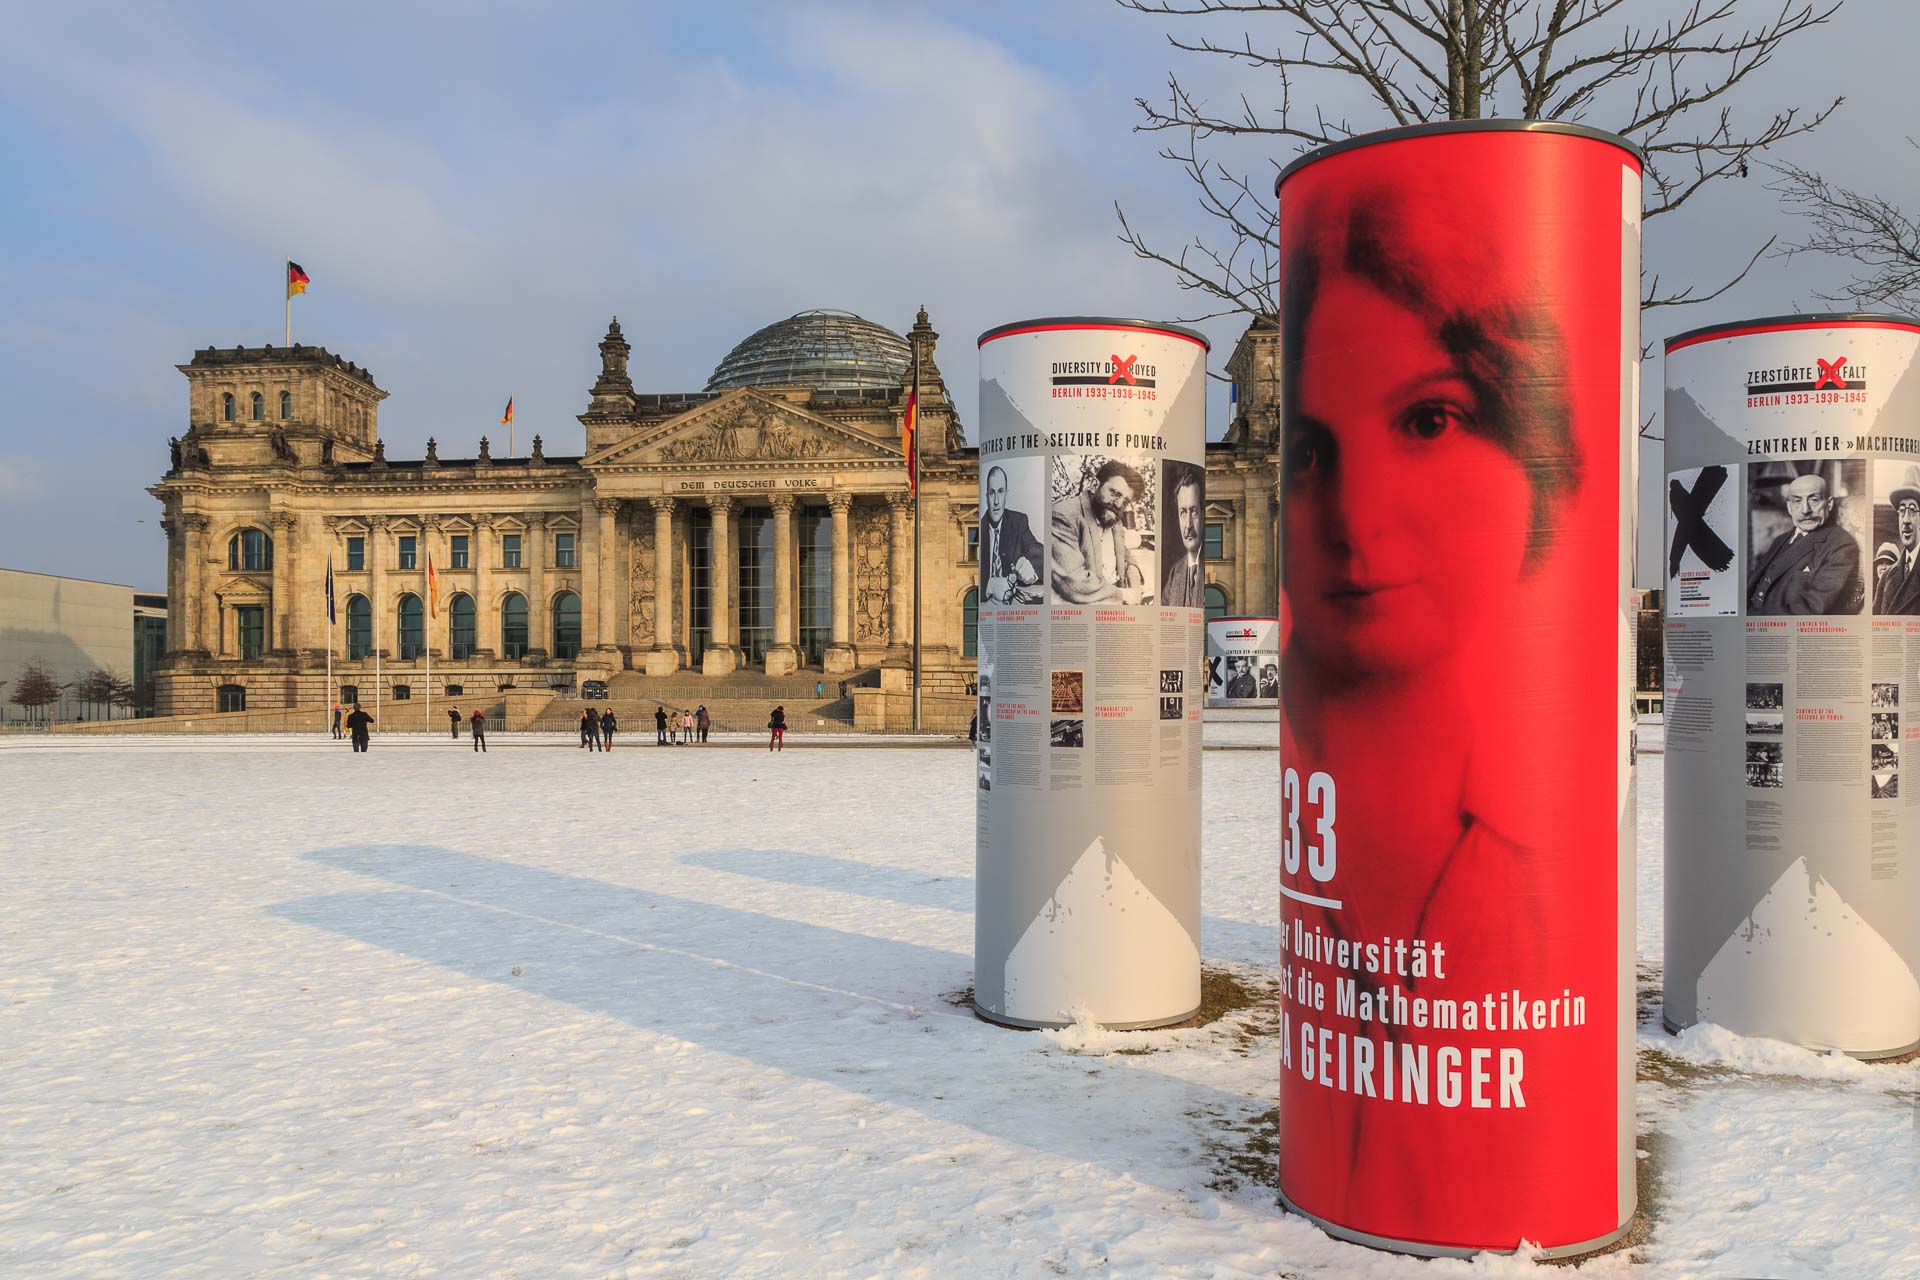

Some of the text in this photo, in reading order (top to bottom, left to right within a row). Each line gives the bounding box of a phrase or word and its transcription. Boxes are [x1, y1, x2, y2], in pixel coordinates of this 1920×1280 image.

[1052, 361, 1156, 377] DIVERSITY DEROYED
[1747, 366, 1812, 384] ZERSTÖRTE
[1052, 387, 1082, 398] BERLIN
[1747, 394, 1781, 408] BERLIN
[1006, 436, 1017, 450] OF
[1020, 434, 1038, 449] THE
[1106, 433, 1120, 447] OF
[1747, 437, 1808, 455] ZENTREN
[1815, 436, 1840, 451] DER
[681, 479, 817, 490] DEM DEUTSCHEN VOLKE
[1284, 767, 1337, 883] 33
[1280, 917, 1446, 979] er Universität
[1280, 963, 1587, 1032] st die Mathematikerin
[1300, 1021, 1528, 1110] GEIRINGER
